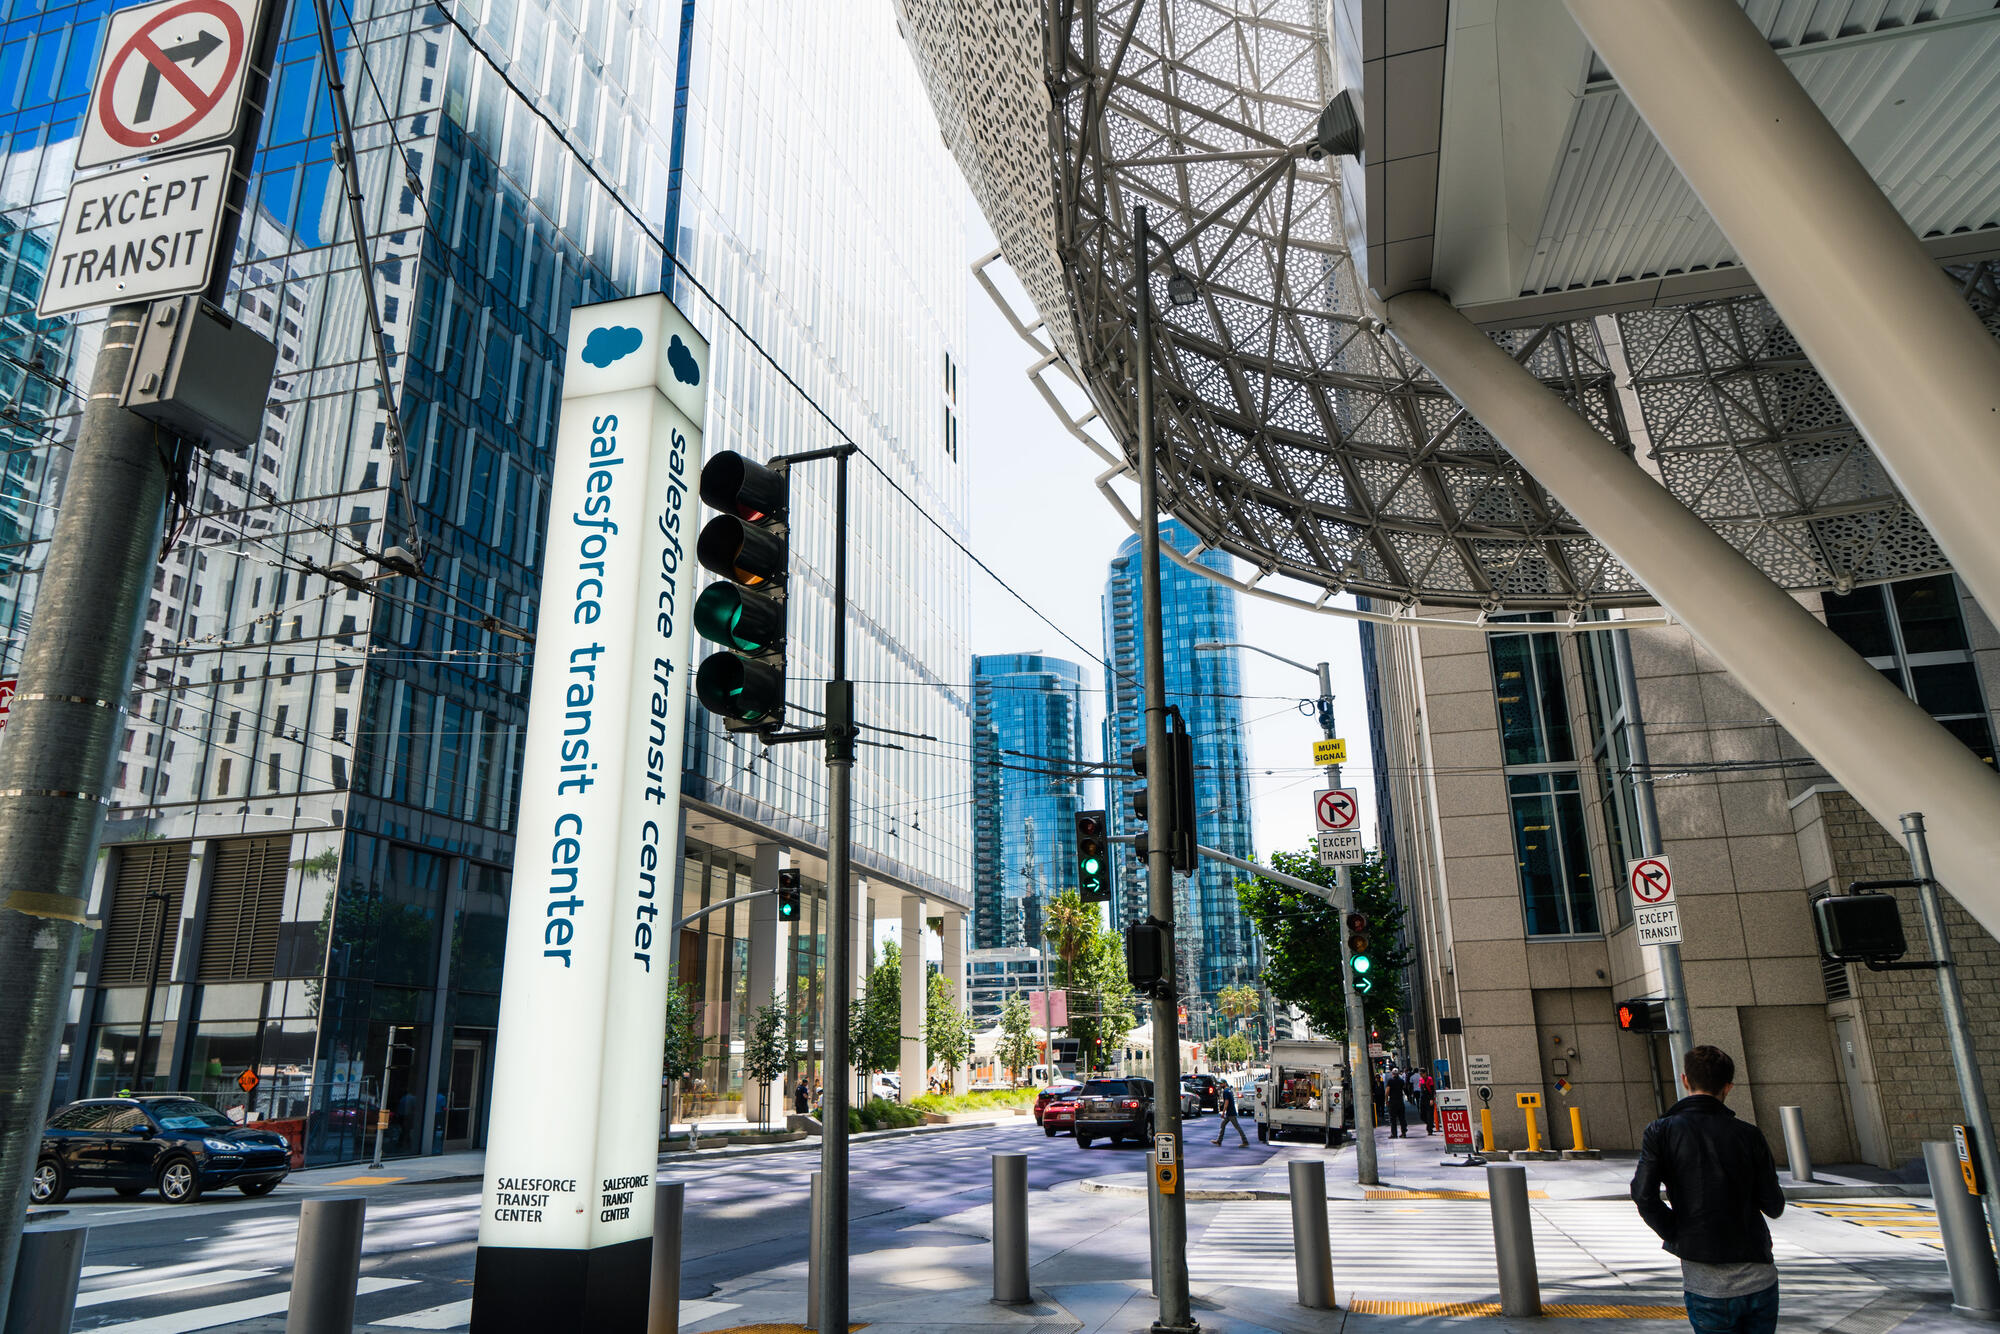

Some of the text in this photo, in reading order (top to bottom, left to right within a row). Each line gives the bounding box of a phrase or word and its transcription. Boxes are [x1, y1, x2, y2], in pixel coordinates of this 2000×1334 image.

[75, 175, 209, 235] EXCEPT
[60, 229, 203, 289] TRANSIT
[543, 415, 624, 969] salesforce transit center
[634, 428, 688, 973] salesforce transit center
[1318, 743, 1340, 752] MUNI
[1315, 752, 1345, 761] SIGNAL
[1322, 836, 1358, 848] EXCEPT
[1321, 849, 1360, 861] TRANSIT
[1639, 911, 1674, 925] EXCEPT
[1639, 926, 1678, 940] TRANSIT
[1447, 1112, 1463, 1121] LOT
[1447, 1122, 1468, 1132] FULL
[497, 1177, 577, 1193] SALESFORCE
[603, 1175, 649, 1191] SALESFORCE
[496, 1193, 550, 1208] TRANSIT
[601, 1191, 634, 1207] TRANSIT
[494, 1208, 543, 1223] CENTER
[600, 1206, 630, 1223] CENTER
